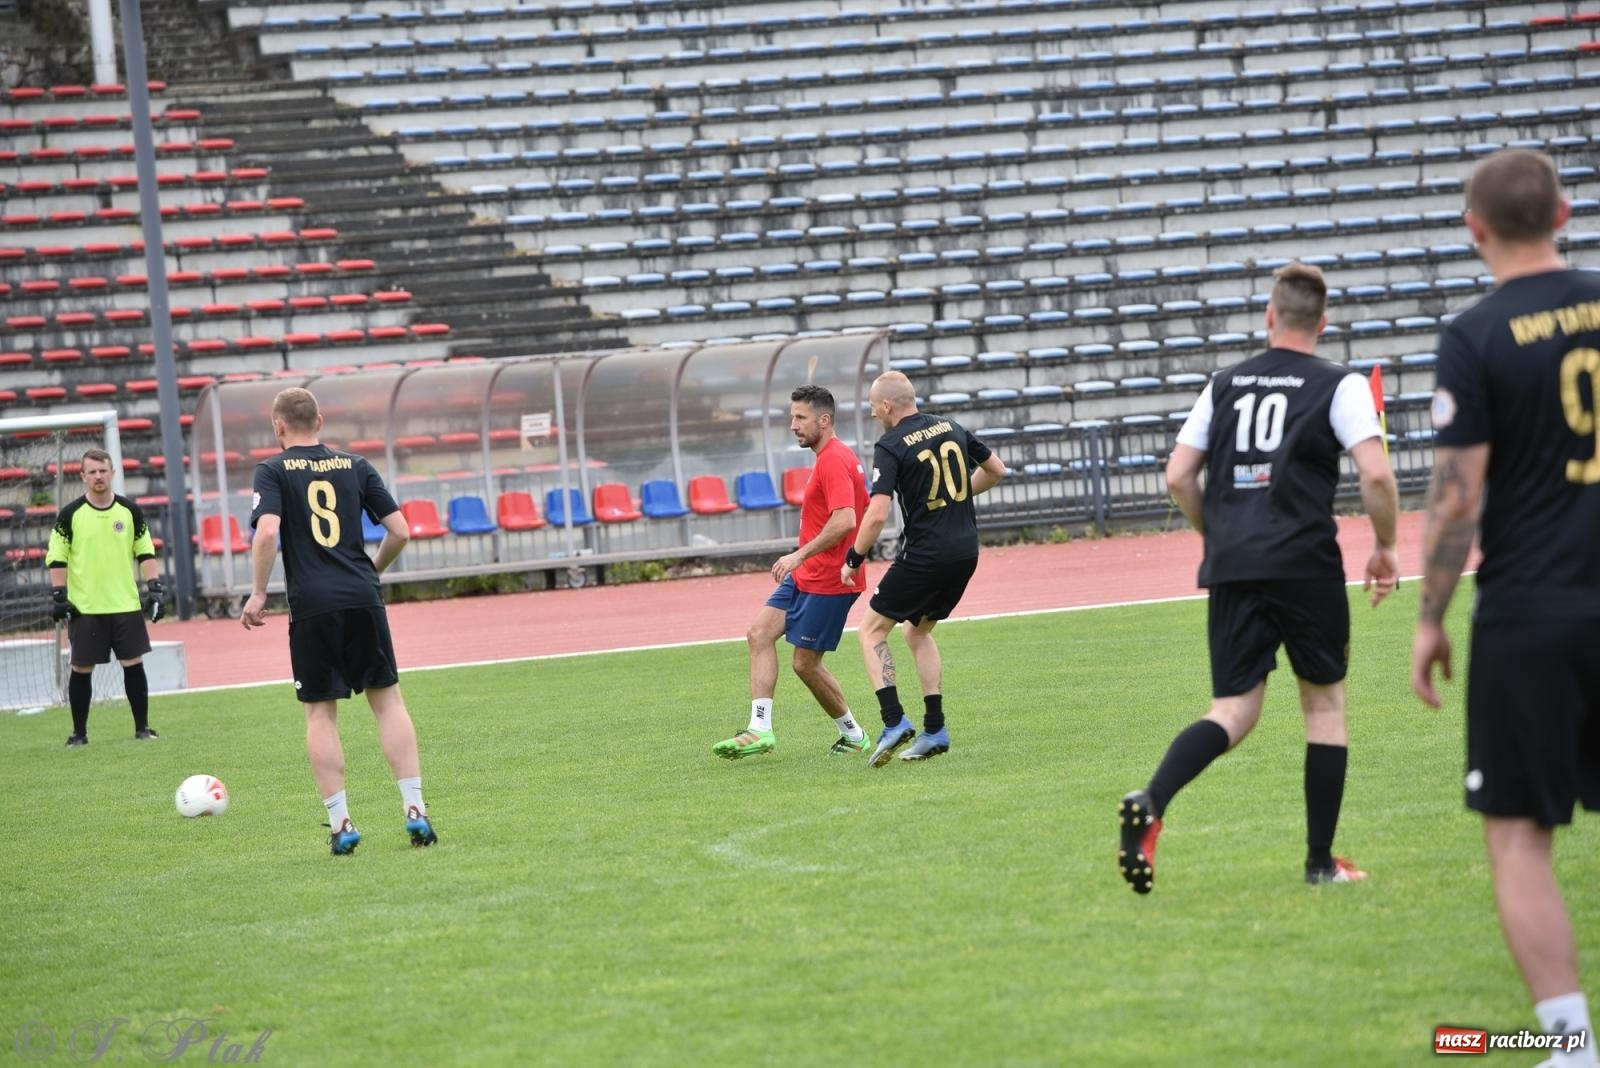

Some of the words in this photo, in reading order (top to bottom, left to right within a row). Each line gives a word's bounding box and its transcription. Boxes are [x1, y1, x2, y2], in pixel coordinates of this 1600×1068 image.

[1508, 310, 1556, 346] KMP
[1231, 375, 1258, 387] KMP
[903, 431, 924, 446] KMP
[1233, 392, 1288, 452] 10
[1560, 347, 1600, 485] 9
[283, 459, 308, 471] KMP
[308, 455, 352, 472] TARNÓW
[917, 440, 967, 511] 20
[307, 480, 340, 548] 8
